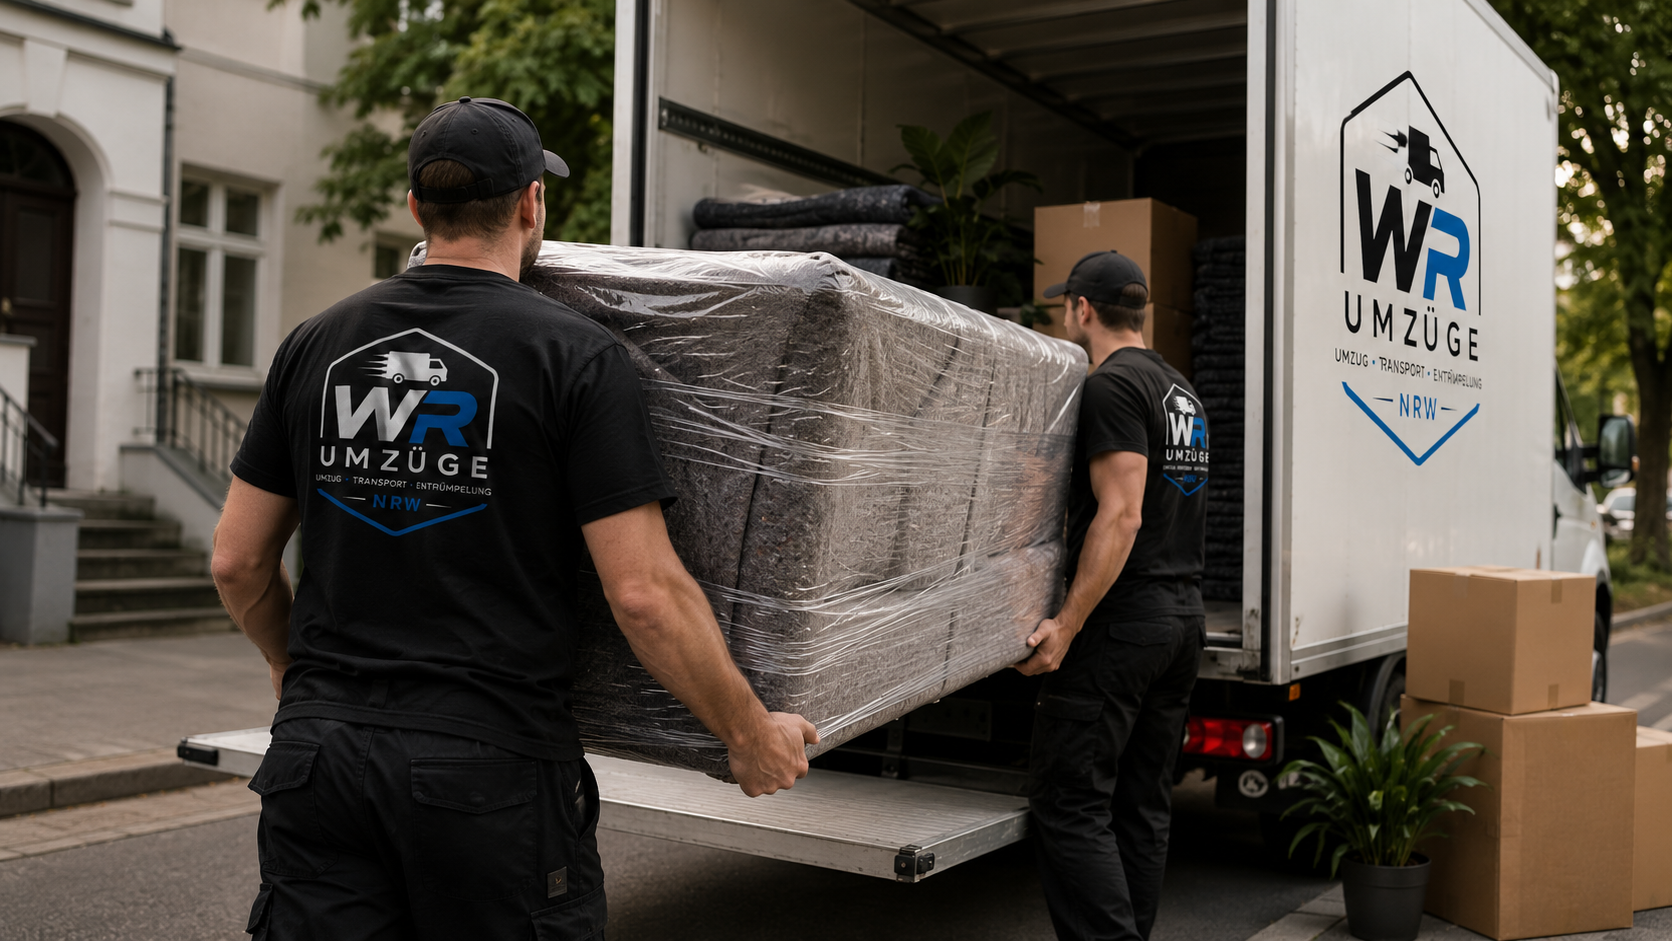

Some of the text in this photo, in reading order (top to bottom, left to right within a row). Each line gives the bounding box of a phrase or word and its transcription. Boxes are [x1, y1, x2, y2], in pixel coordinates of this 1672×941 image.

[1355, 168, 1470, 311] WR
[1344, 290, 1478, 362] UMZÜGE
[1335, 348, 1368, 368] UMZUG
[1379, 356, 1425, 378] TRANSPORT
[335, 385, 478, 448] WR
[1399, 392, 1437, 420] NRW
[1169, 412, 1206, 449] WR
[320, 445, 488, 479] UMZÜGE
[1165, 448, 1209, 463] UMZÜGE
[315, 474, 492, 496] UMZUG TRANSPORT ENTRÜMPELUNG
[372, 494, 421, 512] NRW
